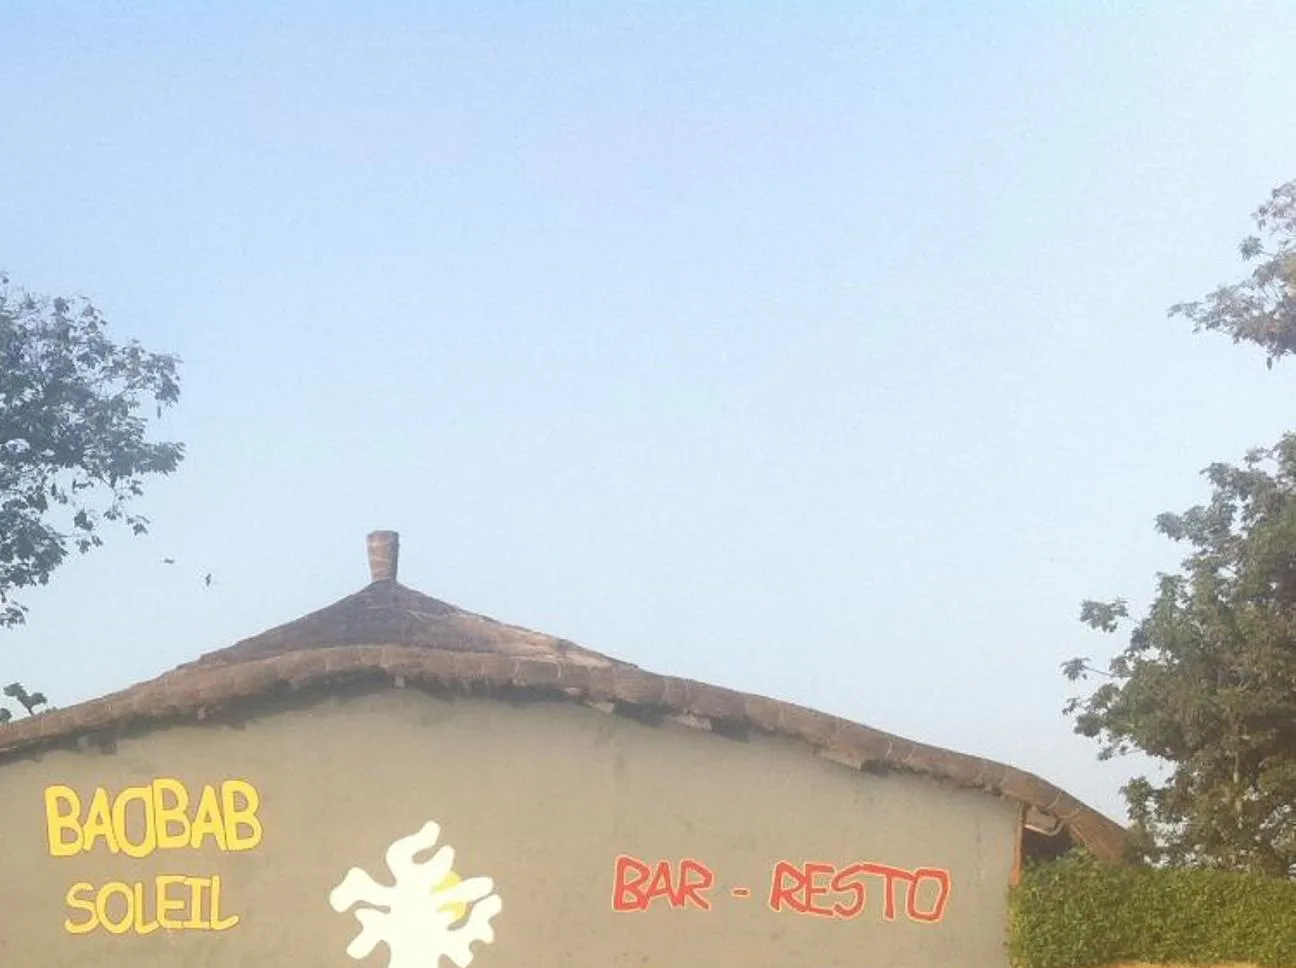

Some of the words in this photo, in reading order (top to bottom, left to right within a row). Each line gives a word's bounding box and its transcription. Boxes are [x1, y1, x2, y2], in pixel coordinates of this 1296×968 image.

[44, 778, 263, 858] BAOBAB
[64, 875, 239, 934] SOLEIL
[611, 855, 714, 912] BAR
[731, 886, 750, 898] -
[769, 860, 951, 922] RESTO
